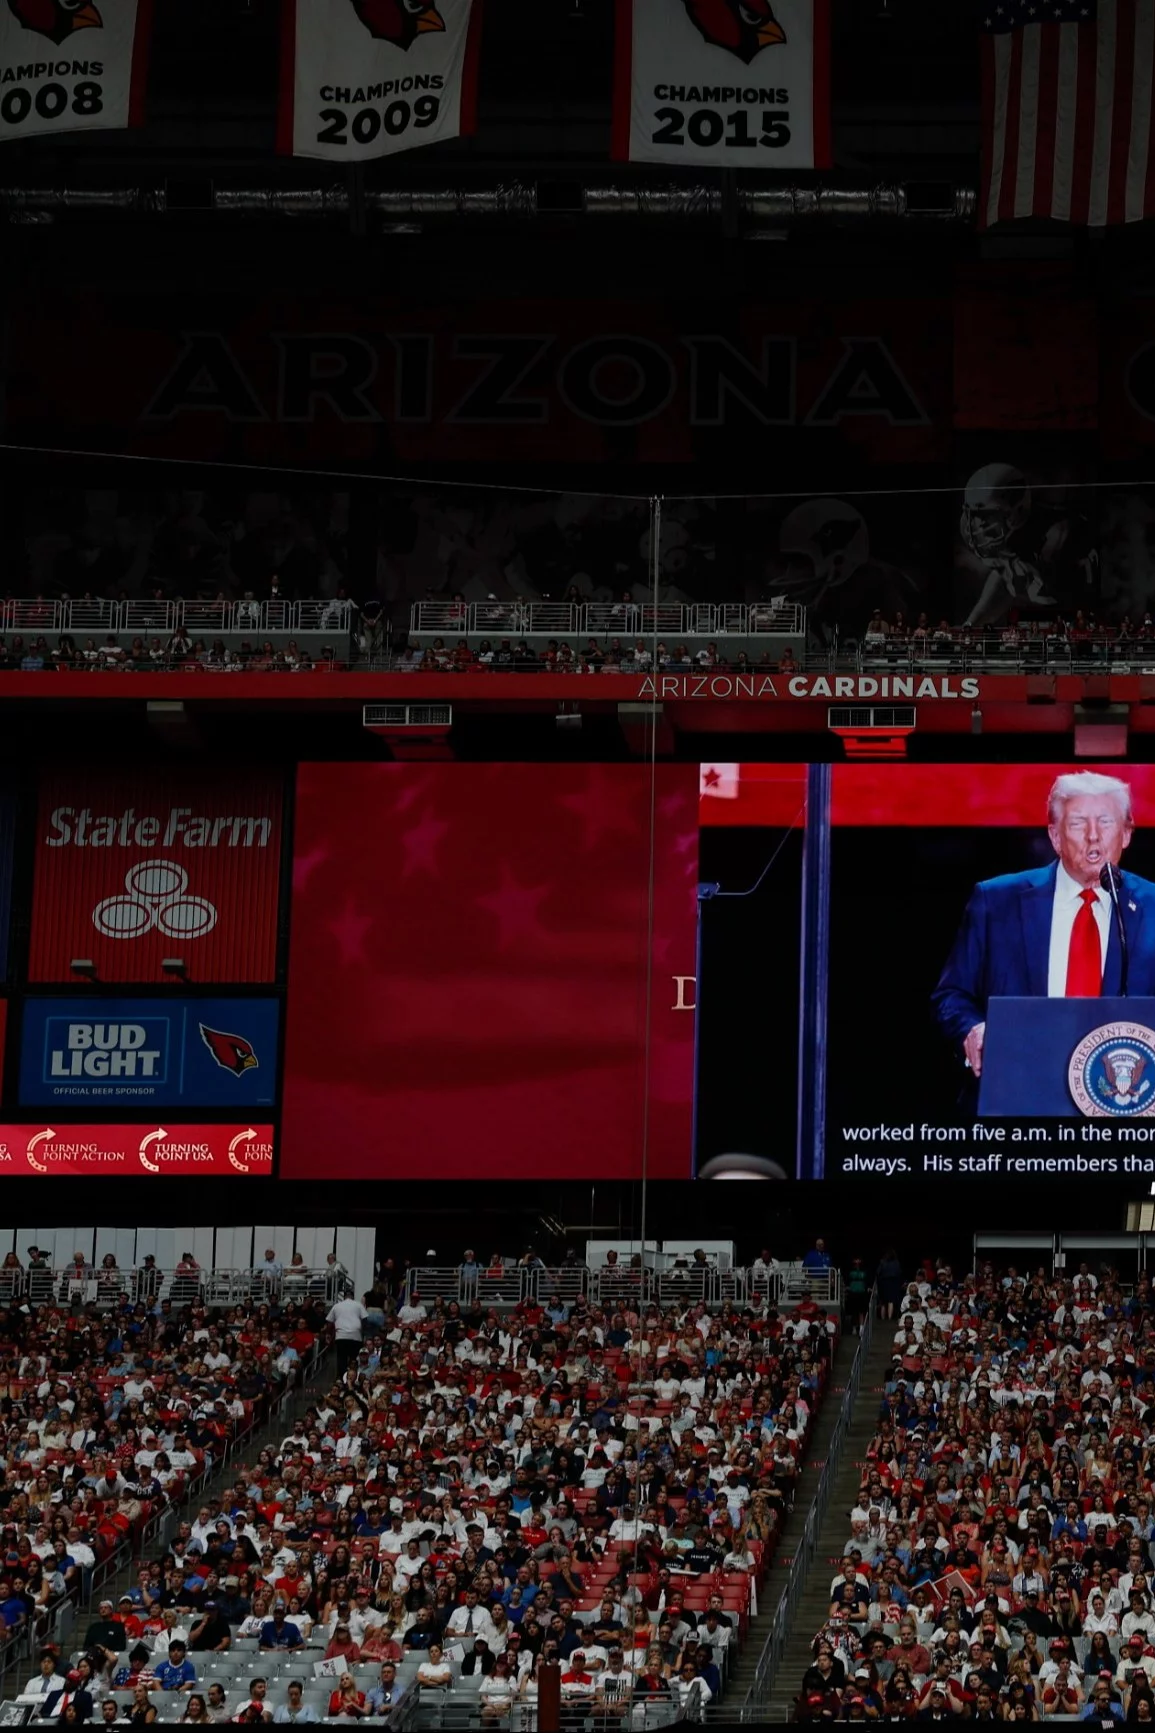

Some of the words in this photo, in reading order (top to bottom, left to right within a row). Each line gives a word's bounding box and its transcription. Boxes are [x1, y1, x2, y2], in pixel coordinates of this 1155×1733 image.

[0, 61, 103, 83] AMPIONS
[319, 74, 443, 103] CHAMPIONS
[654, 84, 789, 105] CHAMPIONS
[317, 95, 440, 146] 2009
[651, 108, 790, 148] 2015
[140, 331, 932, 428] ARIZONA
[638, 676, 777, 698] ARIZONA
[788, 676, 980, 699] CARDINALS
[46, 806, 161, 848] State
[164, 807, 272, 849] Farm
[67, 1024, 146, 1050] BUD
[1073, 1026, 1124, 1072] PRESIDENT
[1126, 1028, 1136, 1036] OF
[1138, 1030, 1152, 1042] THE
[51, 1050, 160, 1077] LIGHT
[53, 1087, 90, 1095] OFFICIAL
[92, 1087, 113, 1095] BEER
[115, 1087, 156, 1095] SPONSOR
[842, 1124, 914, 1142] worked
[920, 1123, 966, 1142] from
[972, 1124, 1006, 1142] five
[1011, 1127, 1052, 1142] a.m.
[1058, 1124, 1076, 1142] in
[1080, 1124, 1112, 1142] the
[43, 1143, 98, 1153] TURNING
[43, 1152, 80, 1161] POINT
[81, 1152, 125, 1161] ACTION
[155, 1143, 209, 1153] TURNING
[155, 1152, 192, 1161] POINT
[193, 1152, 214, 1161] USA
[842, 1154, 912, 1176] always.
[923, 1155, 953, 1173] His
[958, 1154, 1002, 1173] staff
[1006, 1154, 1118, 1173] remembers
